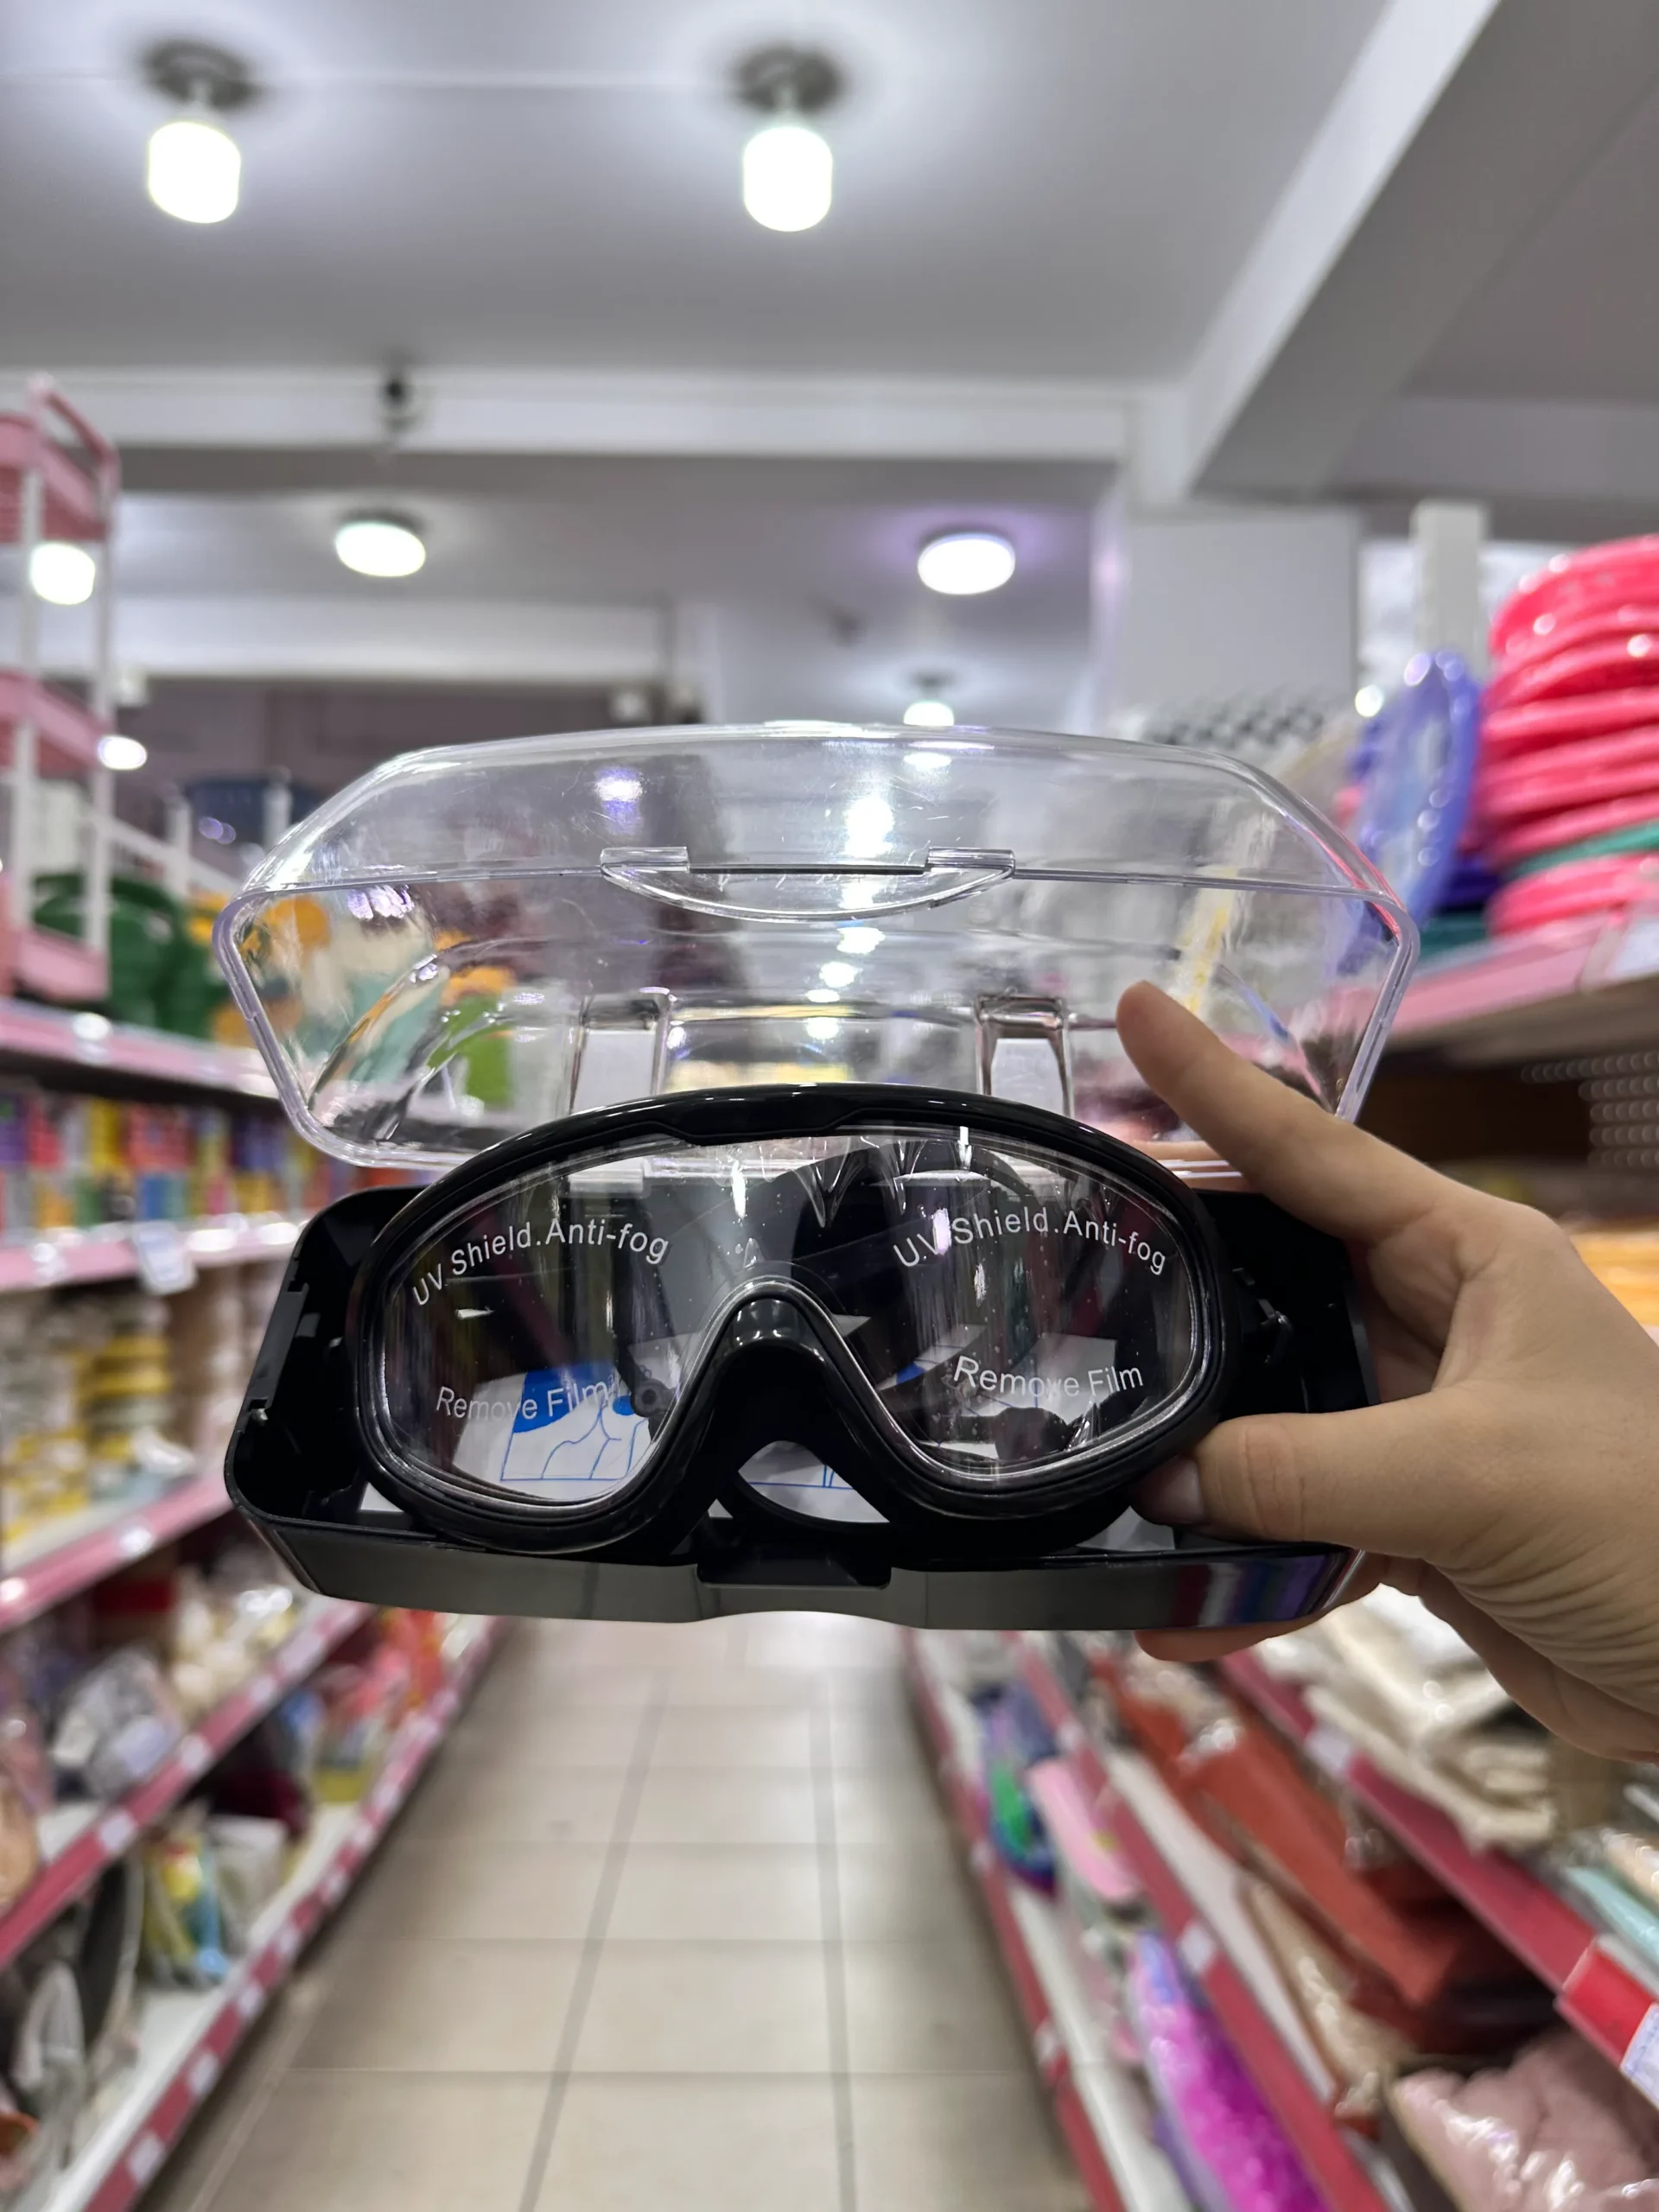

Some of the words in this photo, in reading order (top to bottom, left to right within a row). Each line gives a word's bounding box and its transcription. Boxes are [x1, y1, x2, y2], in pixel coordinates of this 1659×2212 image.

[412, 1262, 444, 1306] UV
[953, 1355, 1079, 1397] Remove
[1088, 1365, 1143, 1396] Film
[436, 1386, 537, 1421] Remove
[547, 1381, 609, 1417] Film
